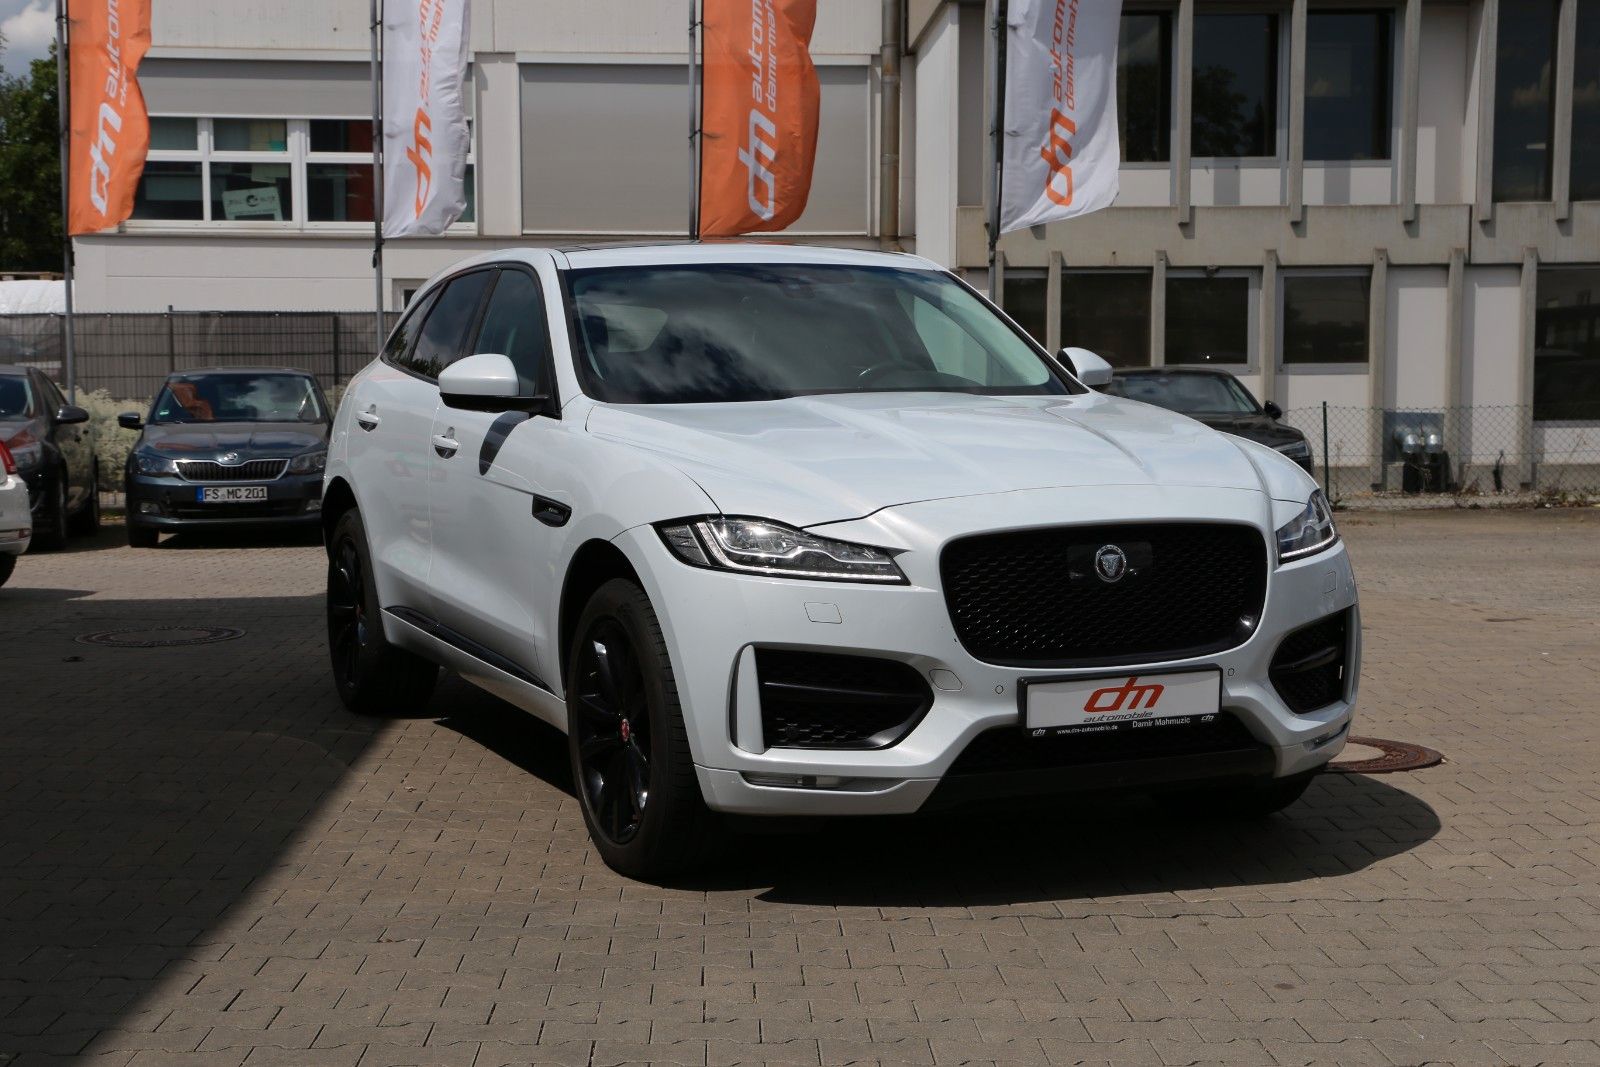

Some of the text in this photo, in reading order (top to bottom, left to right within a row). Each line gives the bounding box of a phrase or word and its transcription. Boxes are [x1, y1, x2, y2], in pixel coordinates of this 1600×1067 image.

[749, 0, 763, 103] autom
[1050, 0, 1066, 102] autom
[204, 487, 266, 500] FS MC 201
[1084, 676, 1165, 712] dm
[1083, 711, 1153, 723] automobile
[1132, 720, 1153, 728] Damir
